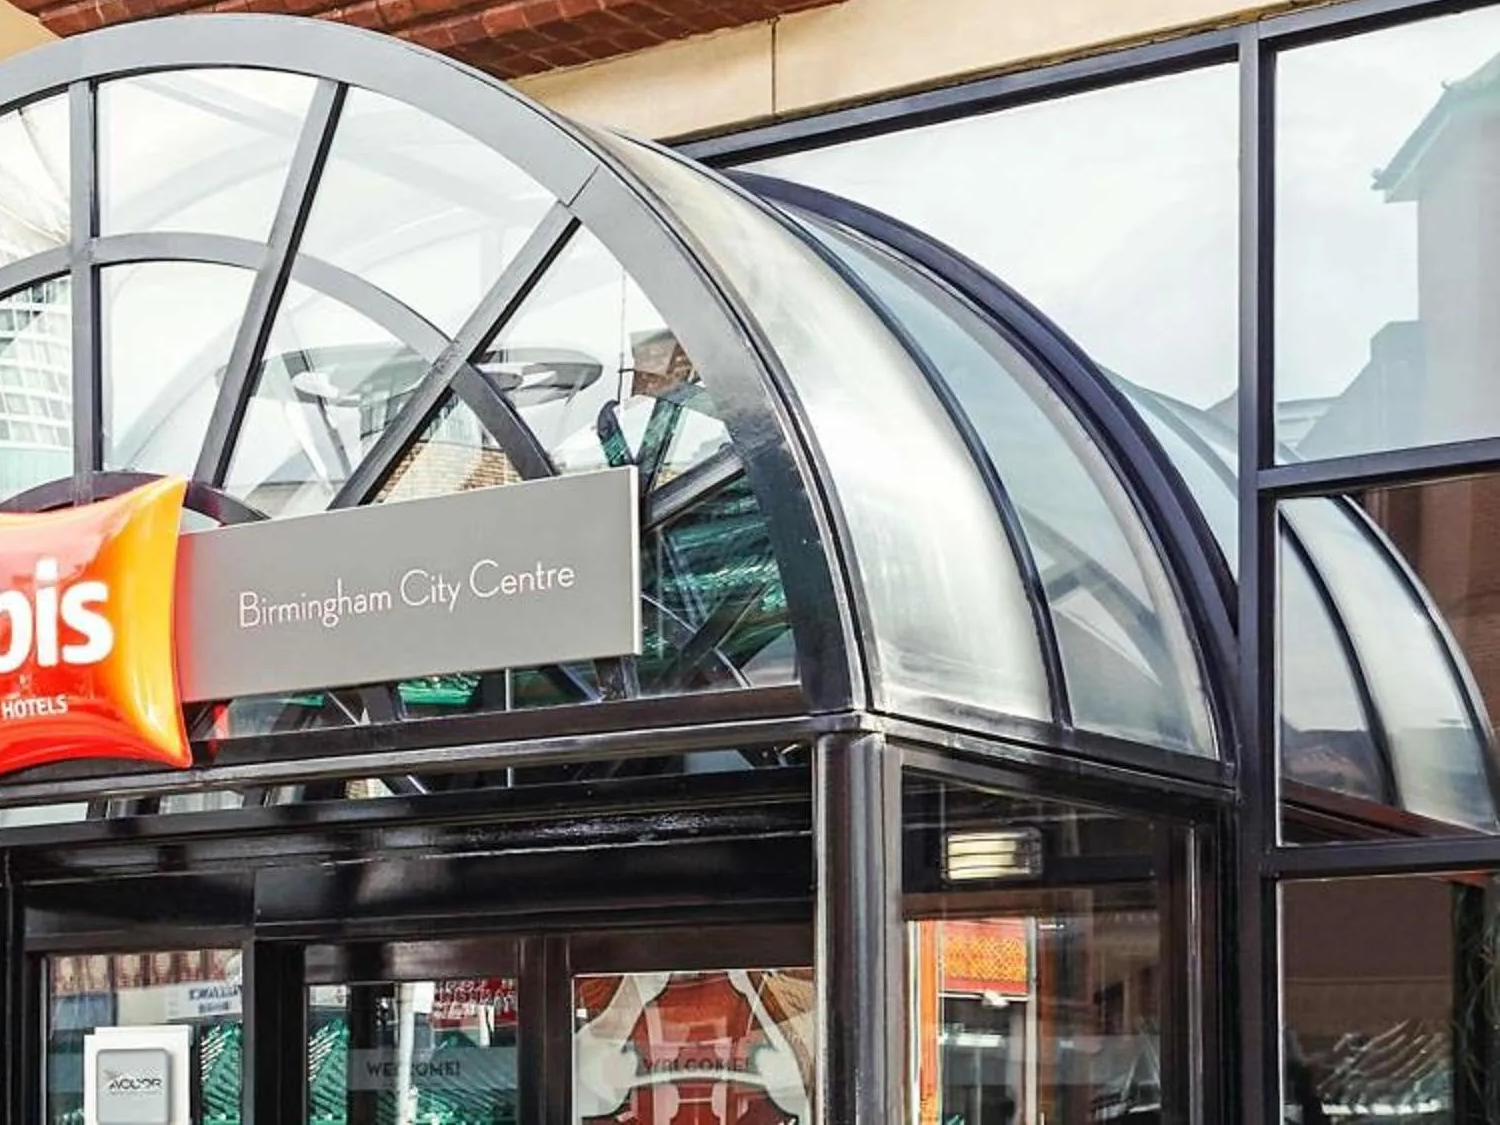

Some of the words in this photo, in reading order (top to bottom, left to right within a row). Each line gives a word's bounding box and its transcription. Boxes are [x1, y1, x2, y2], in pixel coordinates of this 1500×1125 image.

[239, 578, 392, 628] Birmingham
[400, 569, 461, 613] City
[469, 559, 576, 598] Centre
[1, 695, 68, 719] HOTELS
[366, 1059, 461, 1077] WEOME!
